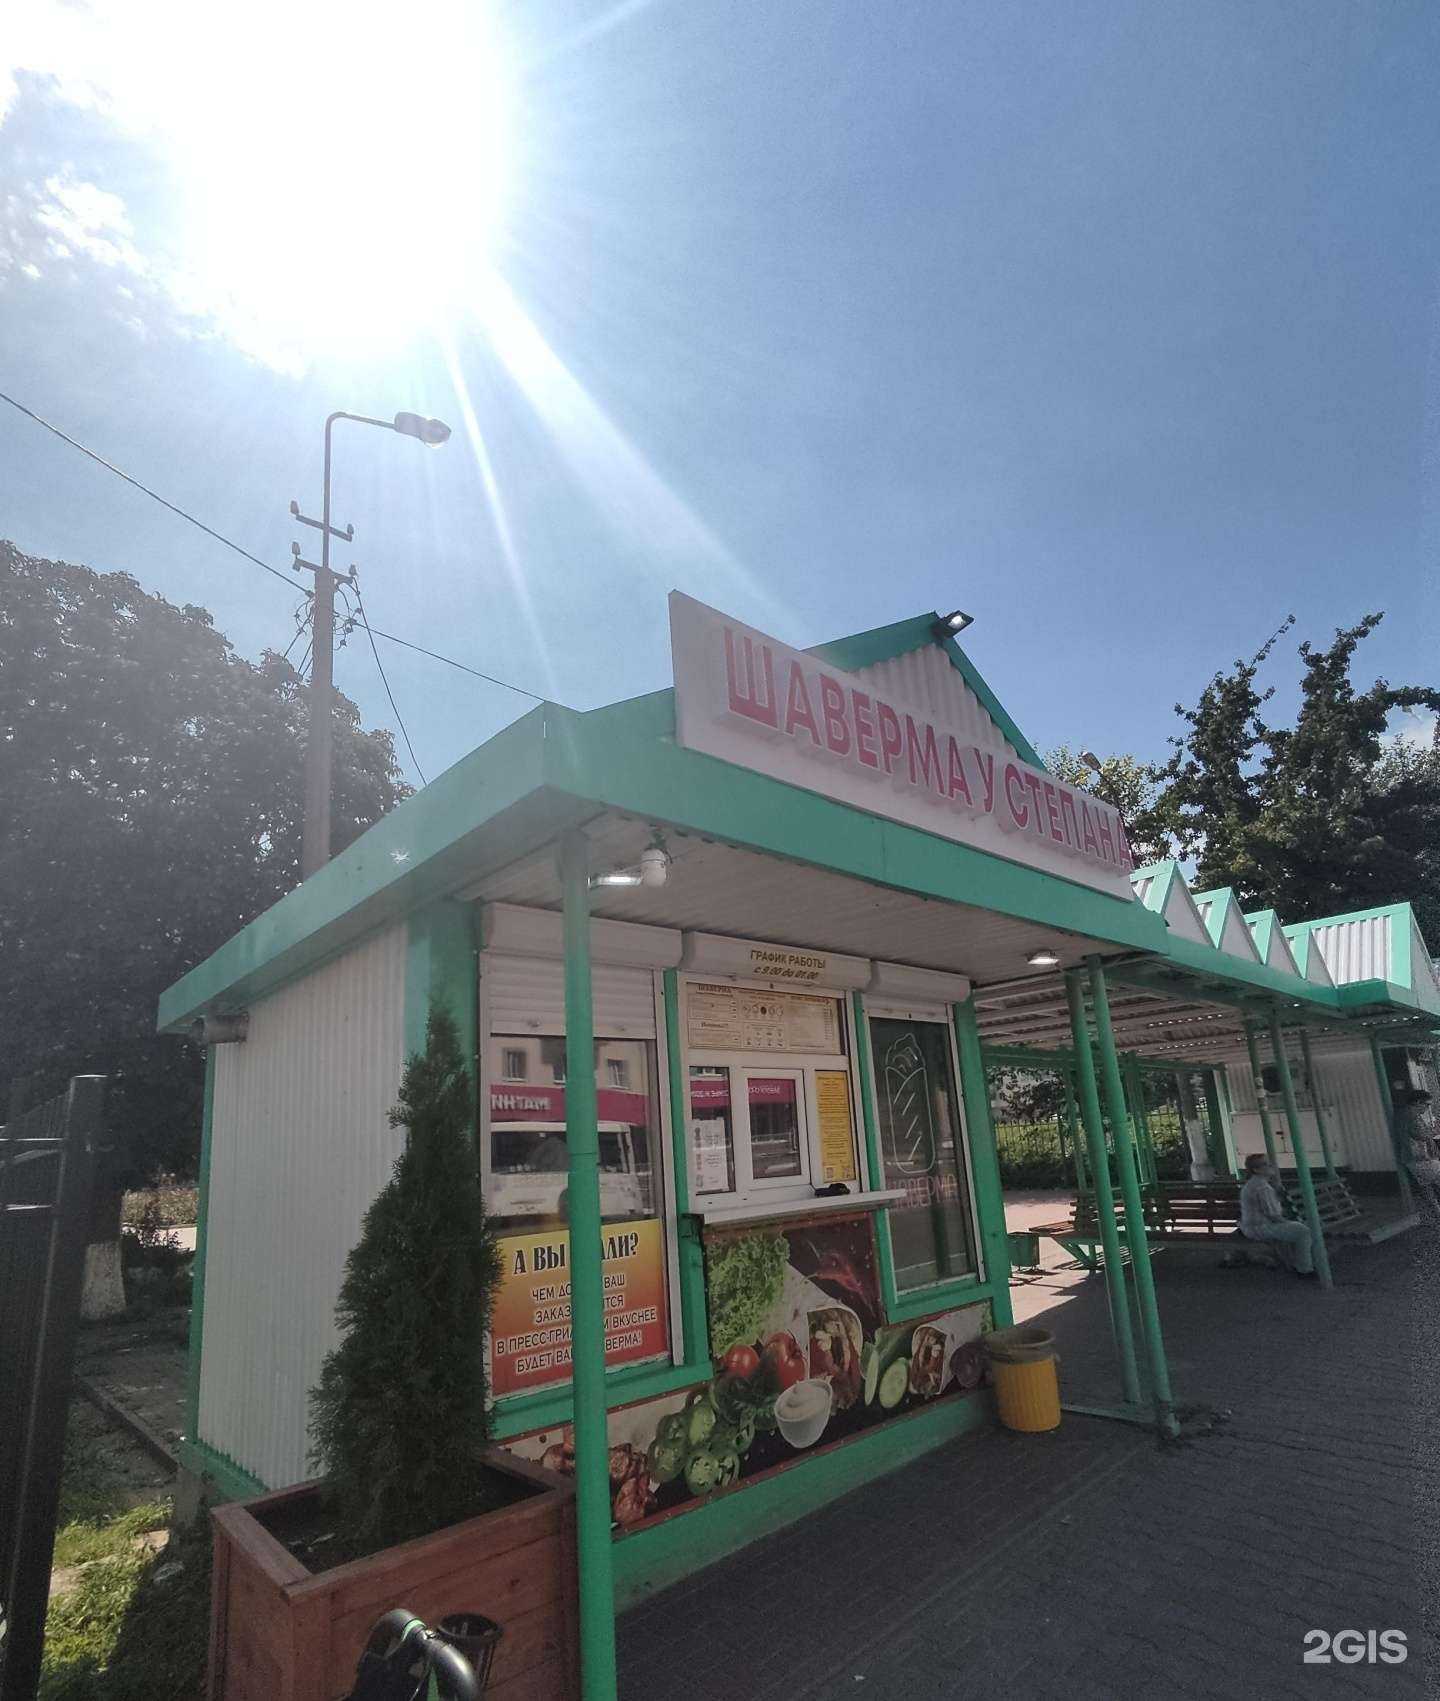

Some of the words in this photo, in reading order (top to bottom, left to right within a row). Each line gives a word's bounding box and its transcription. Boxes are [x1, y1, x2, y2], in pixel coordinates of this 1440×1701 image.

[724, 626, 973, 808] ШАВЕРМА
[974, 747, 994, 813] У
[1004, 762, 1134, 872] СТЕПАНА
[751, 950, 787, 963] ГРАФИК
[788, 955, 826, 968] РАБОТЫ
[514, 1249, 526, 1275] А
[533, 1244, 565, 1271] ВЫ
[532, 1286, 554, 1301] ЧЕМ
[604, 1274, 625, 1289] ВАШ
[535, 1305, 571, 1323] ЗАКАЗ
[497, 1341, 505, 1354] В
[509, 1327, 572, 1353] ПРЕСС-ГРИ
[612, 1308, 657, 1329] ВКУСНЕЕ
[517, 1352, 552, 1373] БУДЕТ
[605, 1332, 641, 1351] ВЕРМА!
